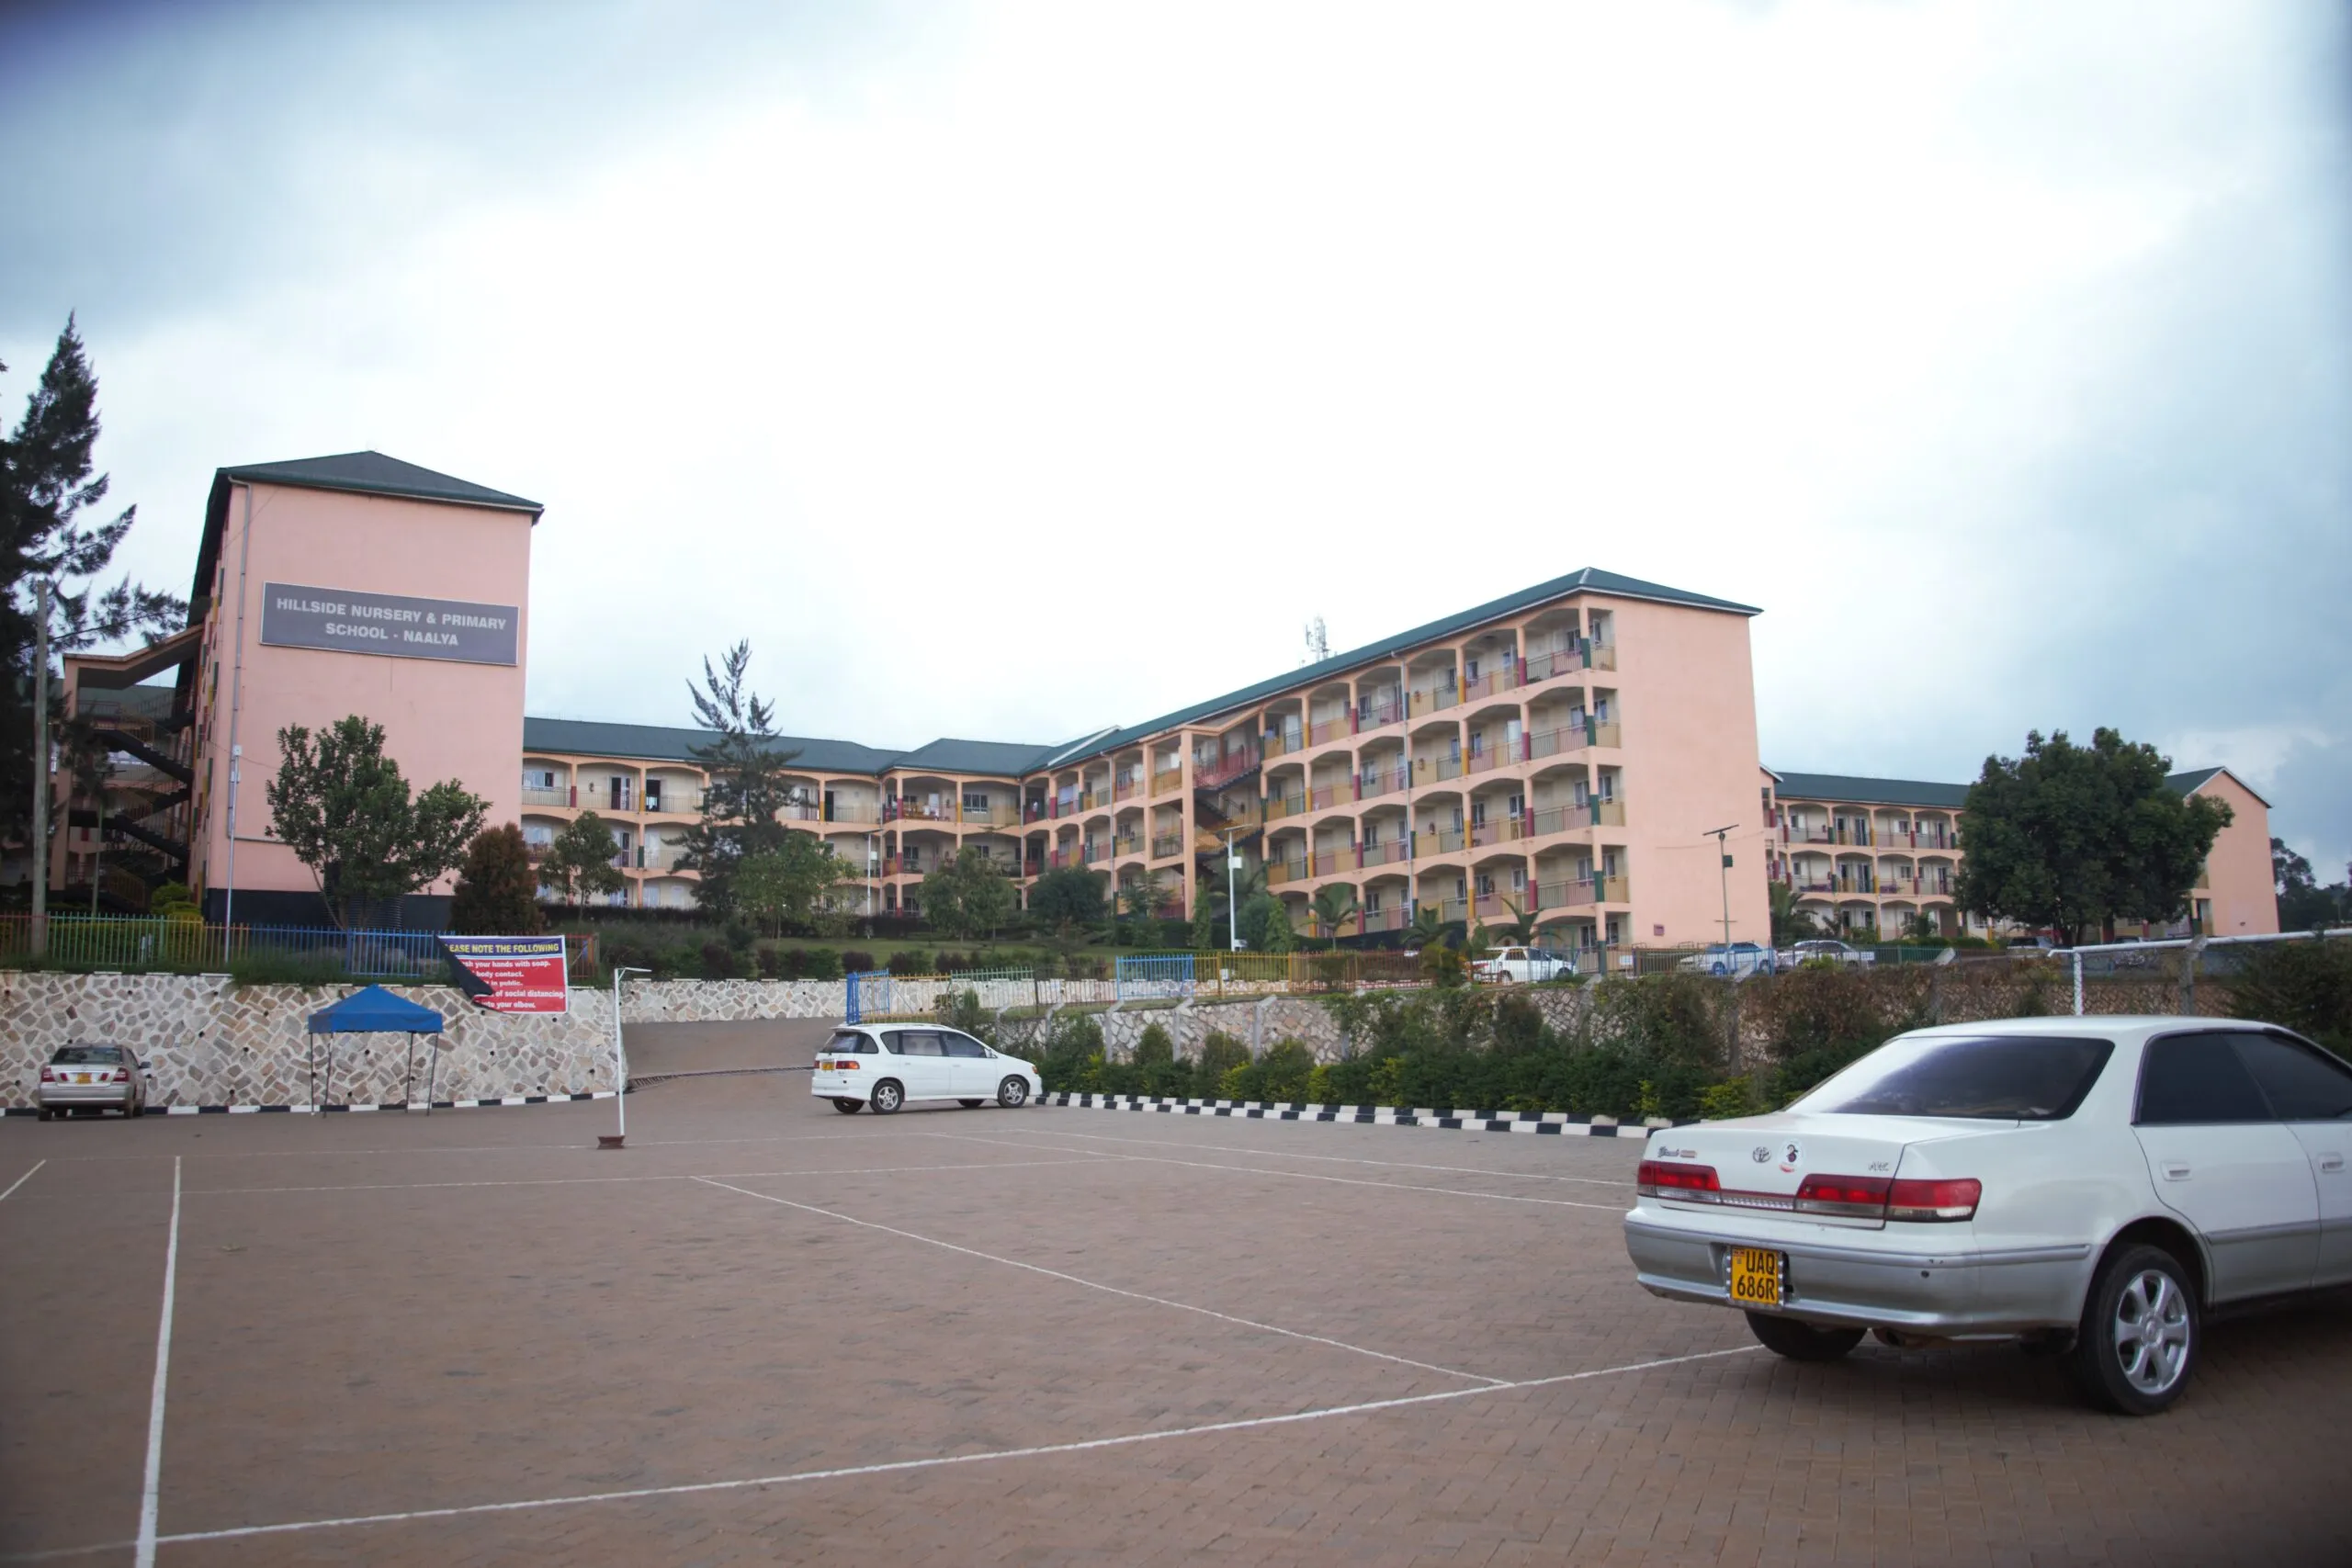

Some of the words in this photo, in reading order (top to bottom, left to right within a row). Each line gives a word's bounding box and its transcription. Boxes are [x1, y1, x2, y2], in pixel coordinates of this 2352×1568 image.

[277, 598, 346, 615] HILLSIDE
[351, 605, 422, 623] NURSERY
[426, 613, 436, 625] &
[442, 614, 507, 631] PRIMARY
[325, 623, 388, 639] SCHOOL
[403, 630, 458, 646] NAALYA
[445, 943, 469, 953] EASE
[471, 944, 493, 953] NOTE
[495, 944, 512, 953] THE
[514, 943, 560, 953] FOLLOWING
[475, 961, 491, 969] your
[504, 989, 526, 998] social
[496, 1001, 513, 1010] your
[1747, 1250, 1775, 1275] UAQ
[1736, 1274, 1775, 1301] 686R
